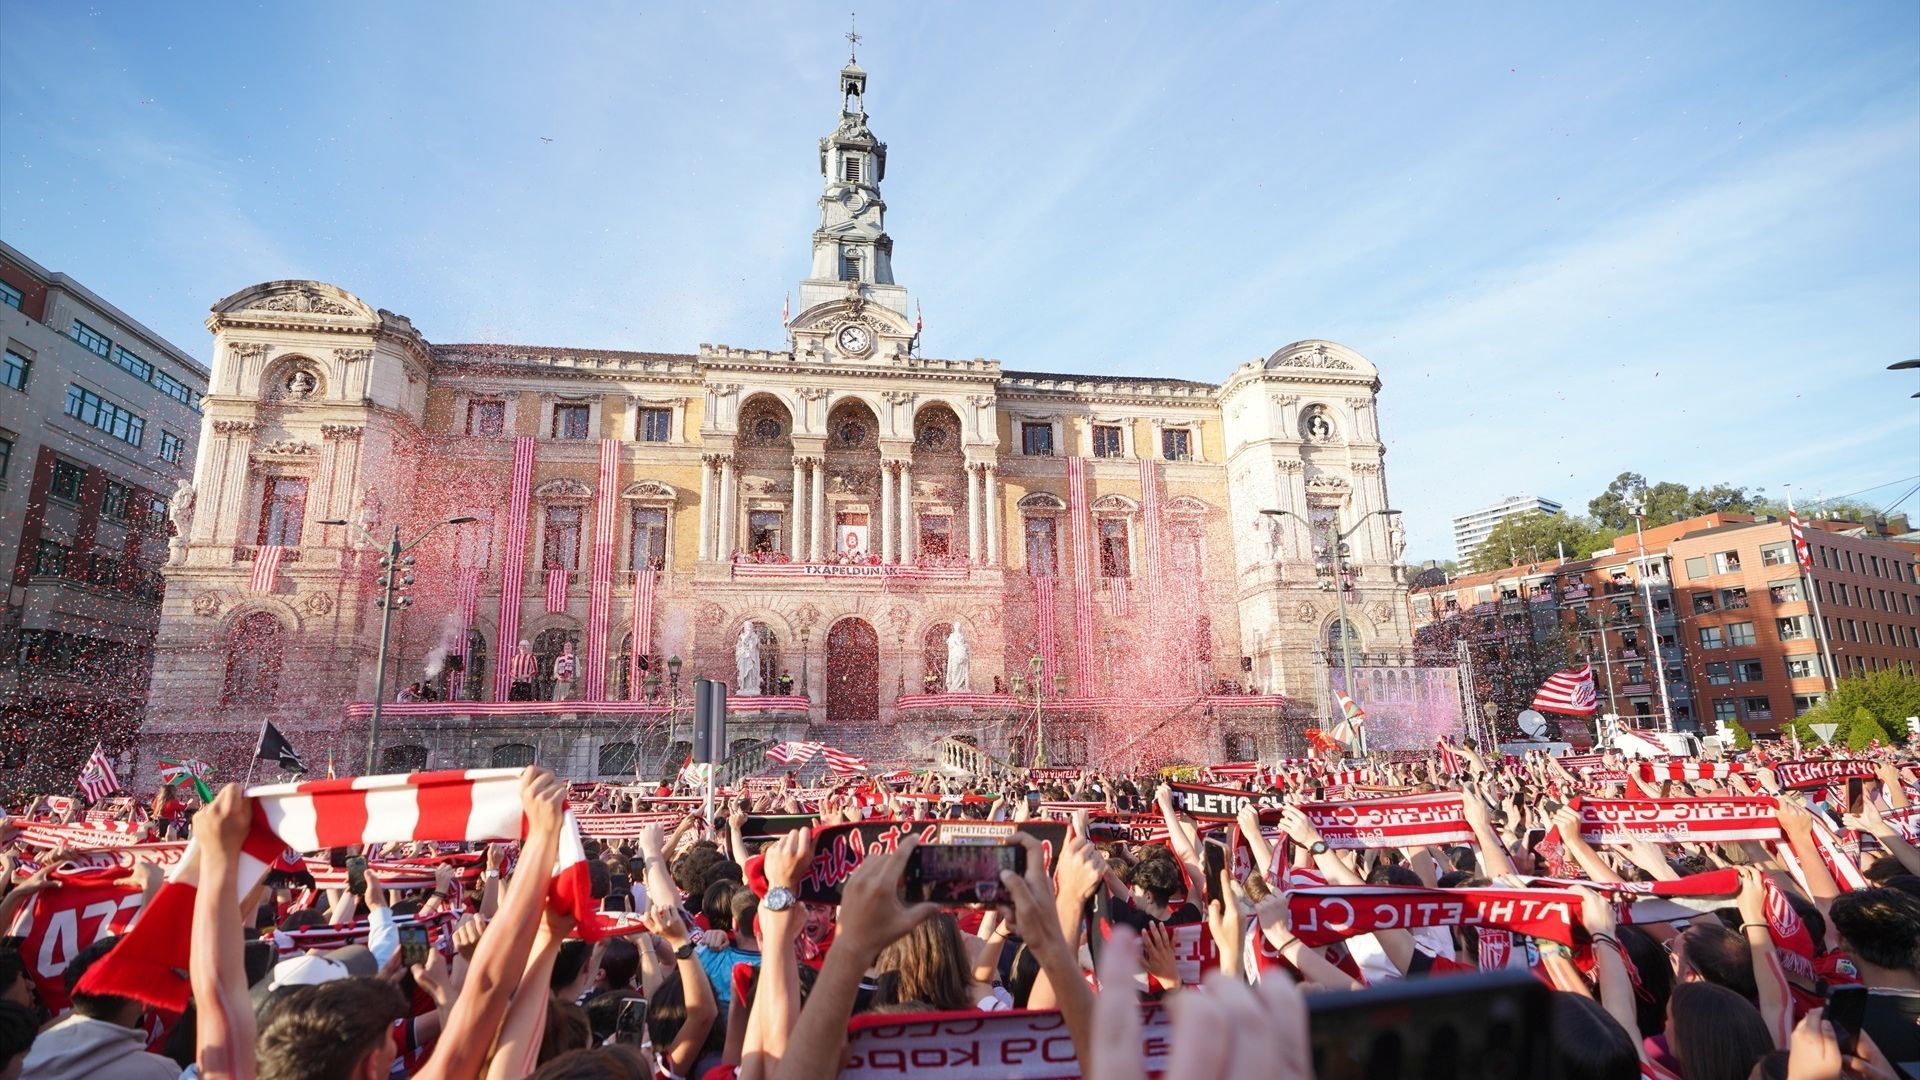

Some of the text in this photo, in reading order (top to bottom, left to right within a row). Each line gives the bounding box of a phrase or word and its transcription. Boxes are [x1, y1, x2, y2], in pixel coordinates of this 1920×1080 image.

[805, 566, 898, 576] TXAPELDUNAK
[1171, 791, 1251, 814] THLETIC
[942, 826, 1013, 835] ATHLETIC CLUB
[1110, 827, 1154, 841] AUPA
